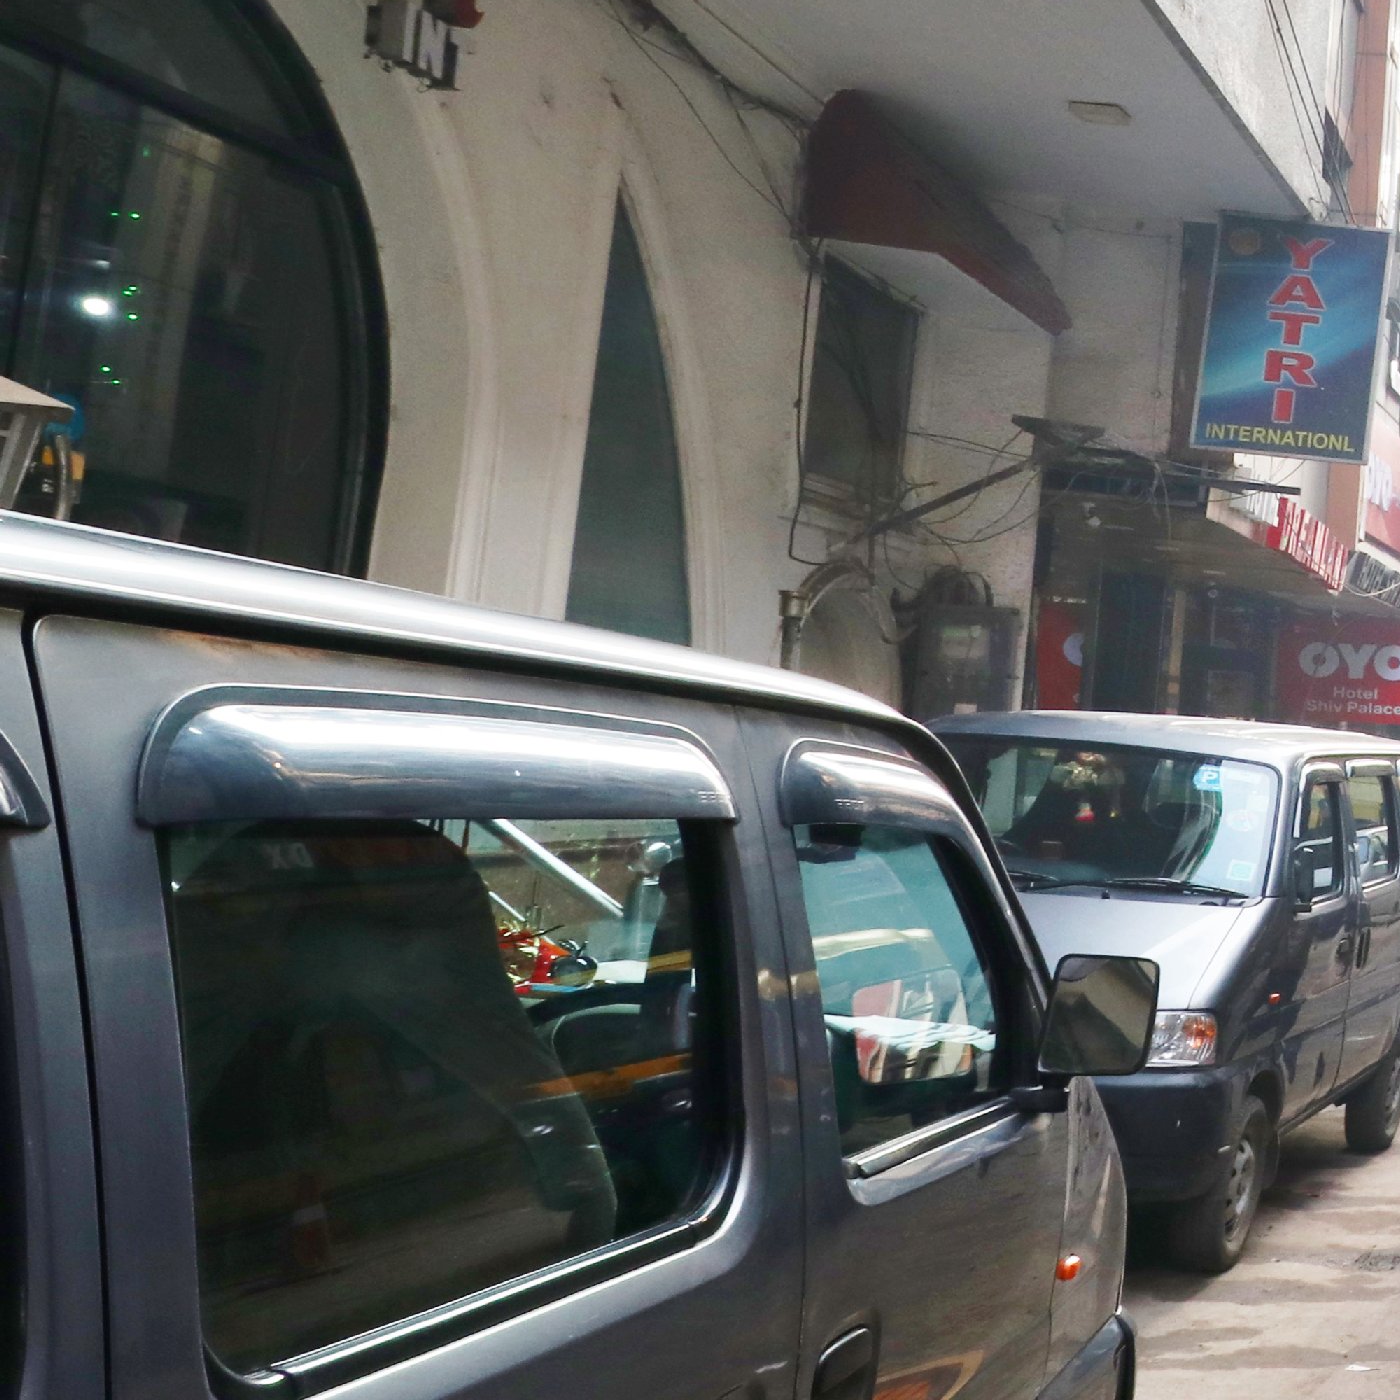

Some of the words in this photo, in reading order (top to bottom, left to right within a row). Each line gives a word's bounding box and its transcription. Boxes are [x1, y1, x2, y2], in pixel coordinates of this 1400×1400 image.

[1262, 237, 1334, 424] YATRI
[1205, 423, 1357, 454] INTERNATIONL
[1333, 686, 1378, 699] Hotel
[1306, 699, 1342, 713] Shiv
